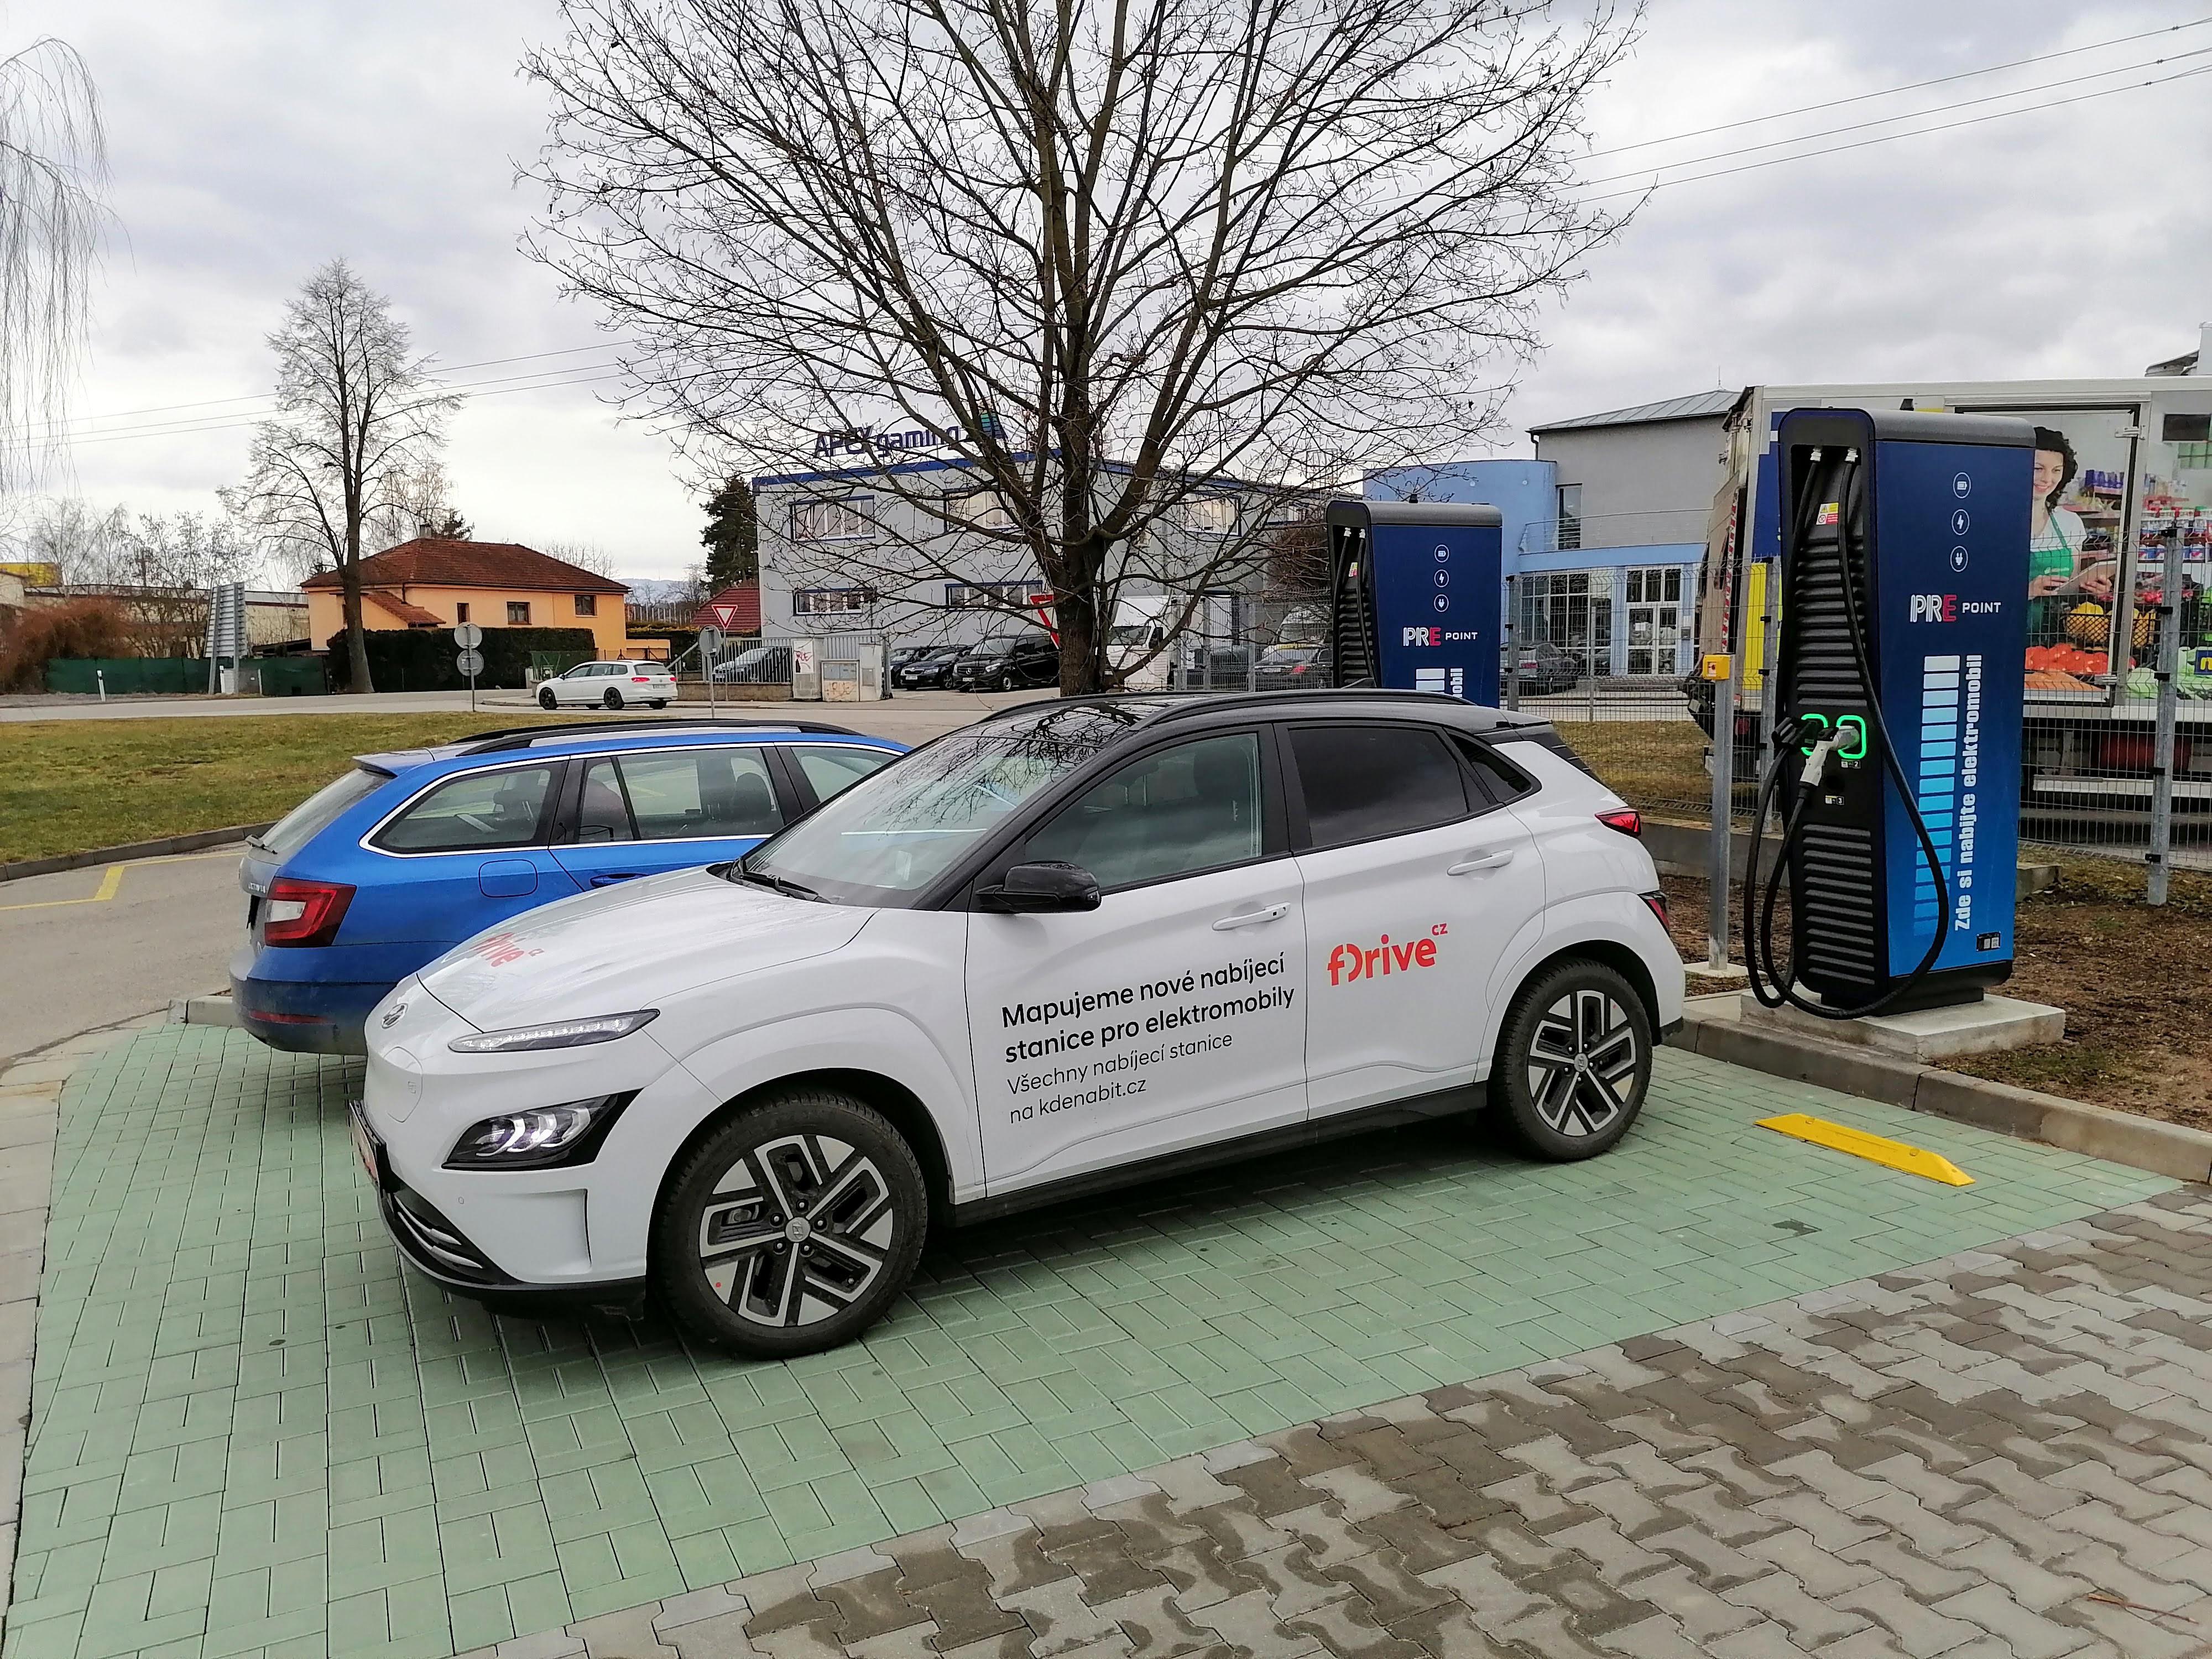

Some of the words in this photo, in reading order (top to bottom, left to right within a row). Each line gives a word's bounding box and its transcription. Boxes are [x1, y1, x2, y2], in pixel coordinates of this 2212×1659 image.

[1910, 594, 1957, 623] PRE
[1962, 602, 2001, 613] POINT
[1403, 627, 1441, 646] PRE
[1446, 632, 1478, 640] POINT
[1961, 655, 1982, 787] elektromobil
[1959, 794, 1977, 864] nabijte
[1957, 869, 1973, 889] si
[1955, 895, 1971, 931] Zde
[1001, 987, 1134, 1027] Mapujeme
[1140, 970, 1194, 1000] nové
[1201, 951, 1285, 989] nabíjecí
[1005, 1030, 1094, 1063] stanice
[1101, 1021, 1139, 1047] pro
[1145, 986, 1295, 1032] elektromobily
[1007, 1066, 1088, 1094] Všechny
[1093, 1044, 1165, 1075] nabíjecí
[1170, 1034, 1233, 1058] stanice
[1010, 1106, 1033, 1123] na
[1040, 1079, 1147, 1115] kdenabit.cz
